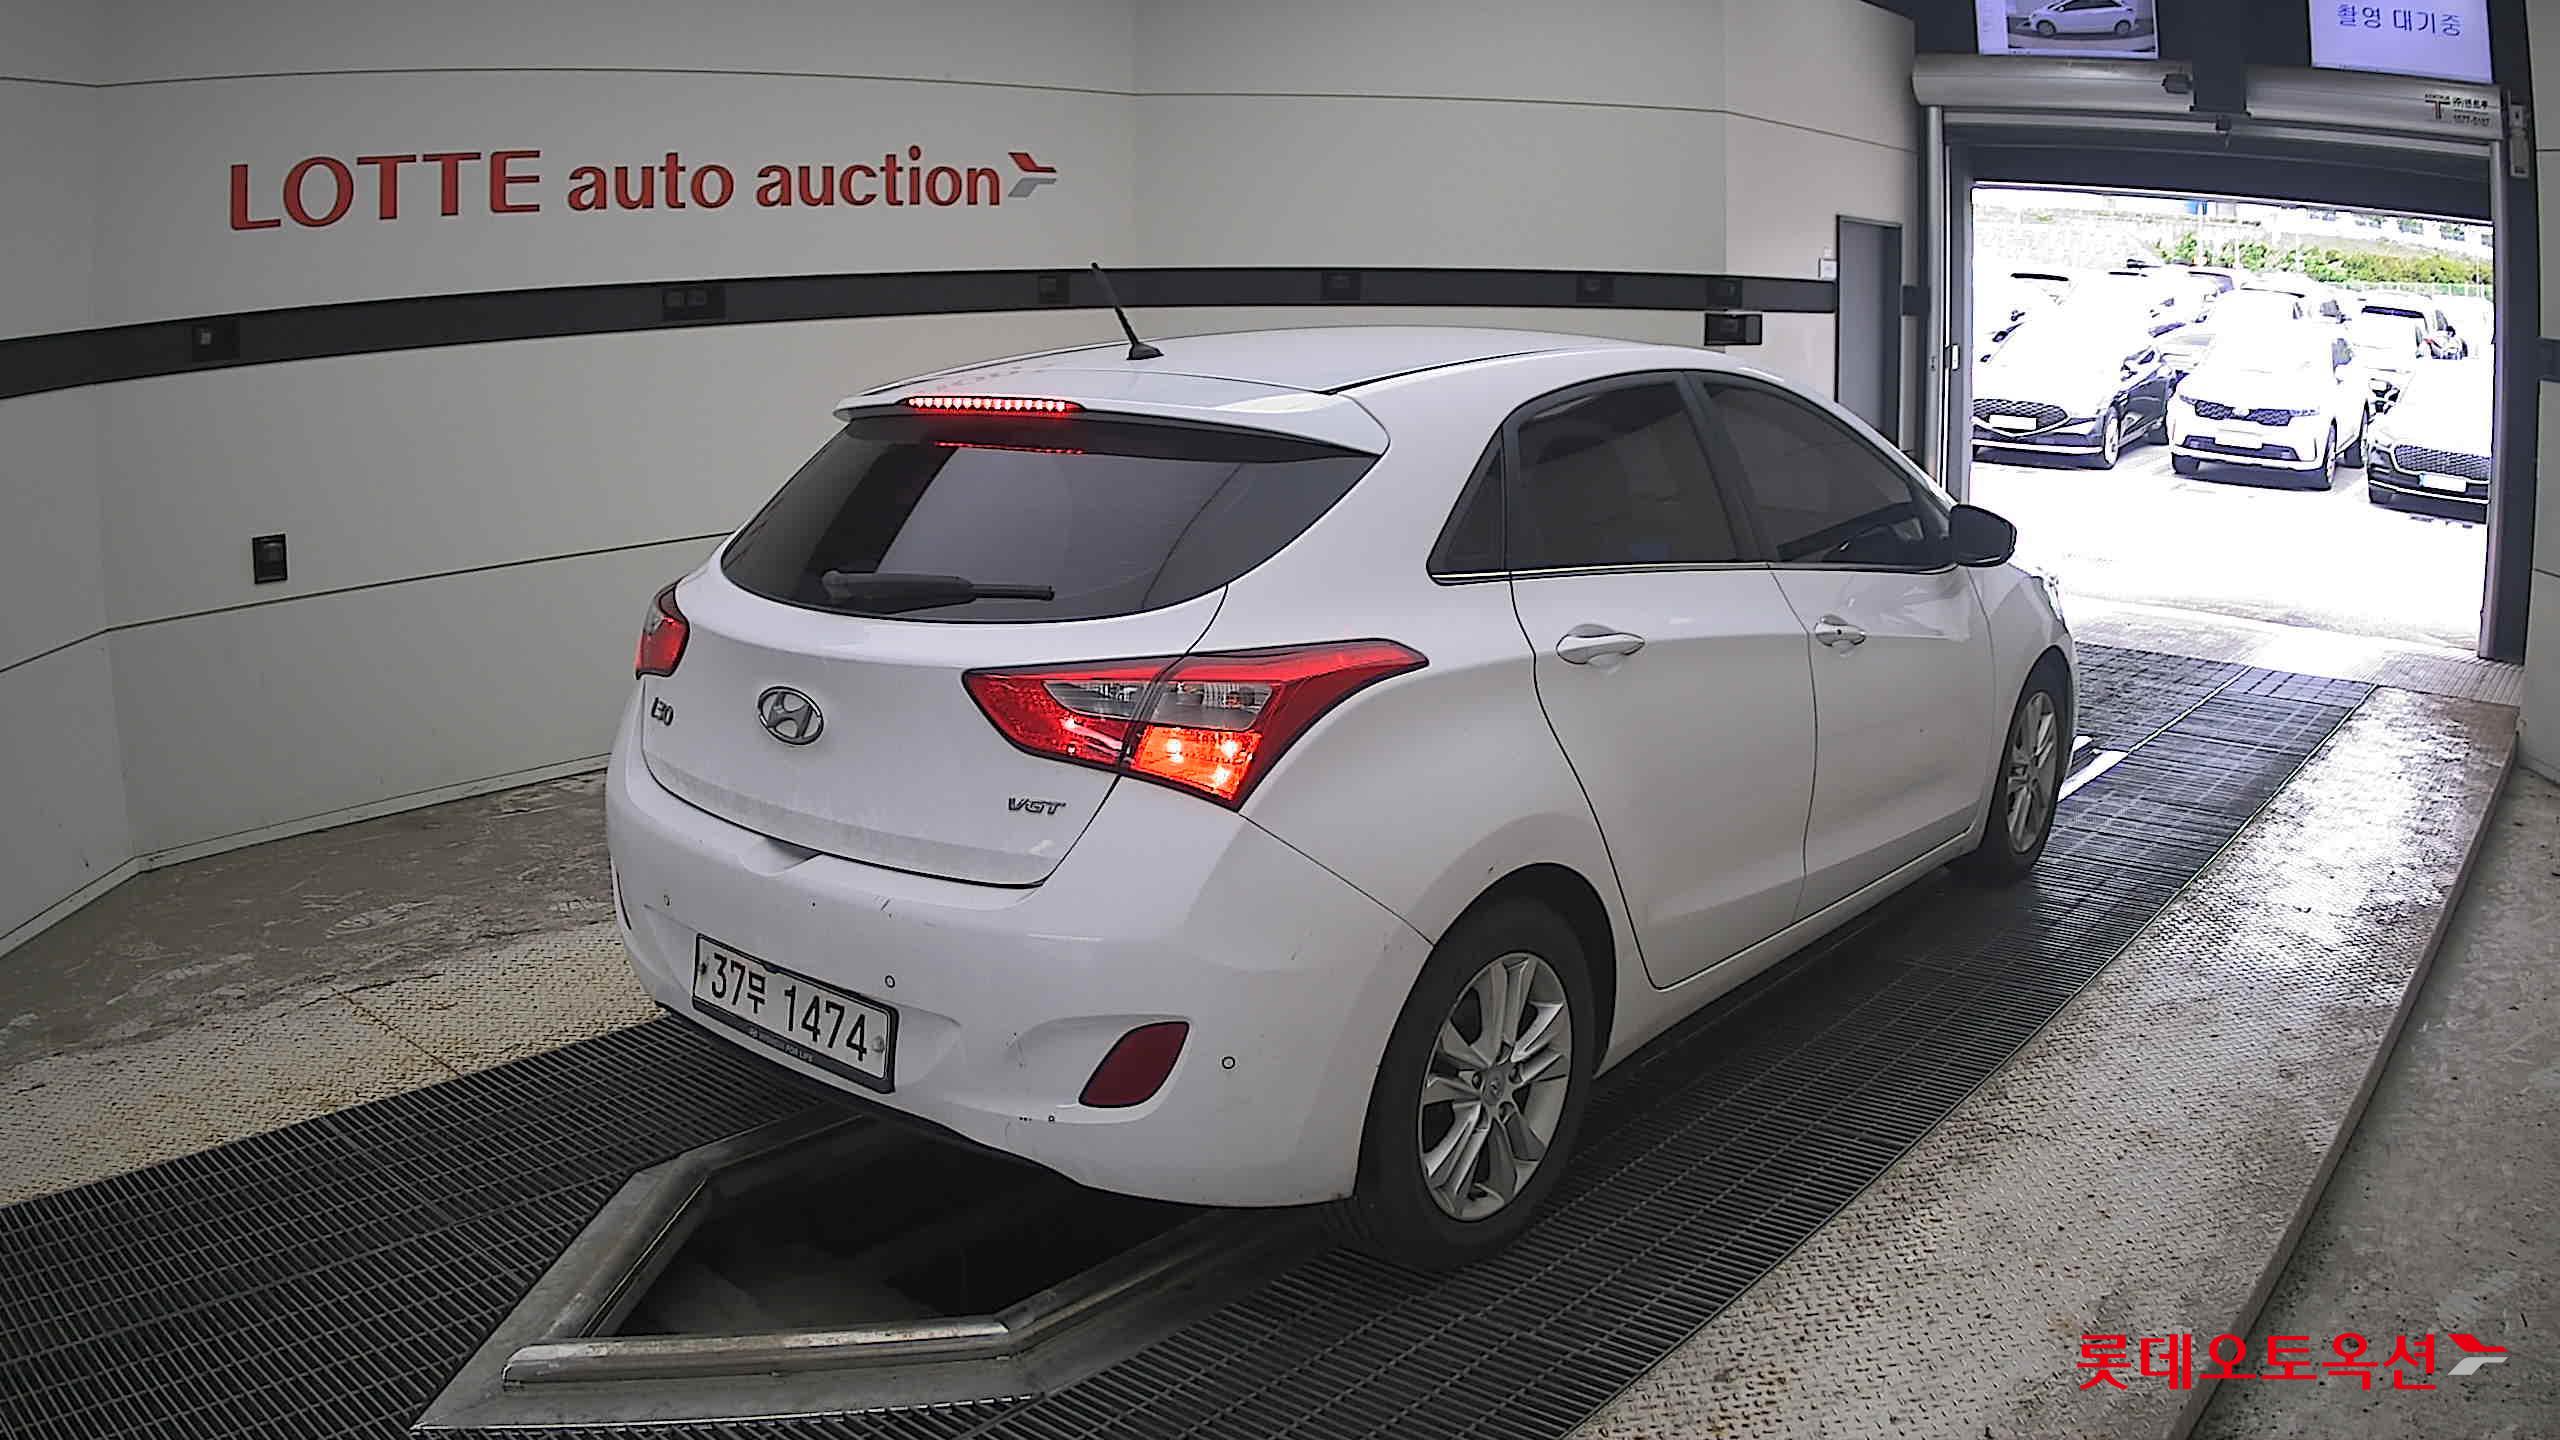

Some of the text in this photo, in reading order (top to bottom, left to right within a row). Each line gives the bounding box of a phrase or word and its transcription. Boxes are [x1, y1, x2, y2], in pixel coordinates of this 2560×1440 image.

[2338, 4, 2461, 37] 촬영 대기중
[229, 146, 1001, 231] LOTTE auto auction
[1008, 797, 1067, 815] VGT
[711, 952, 868, 1062] 37무 1474
